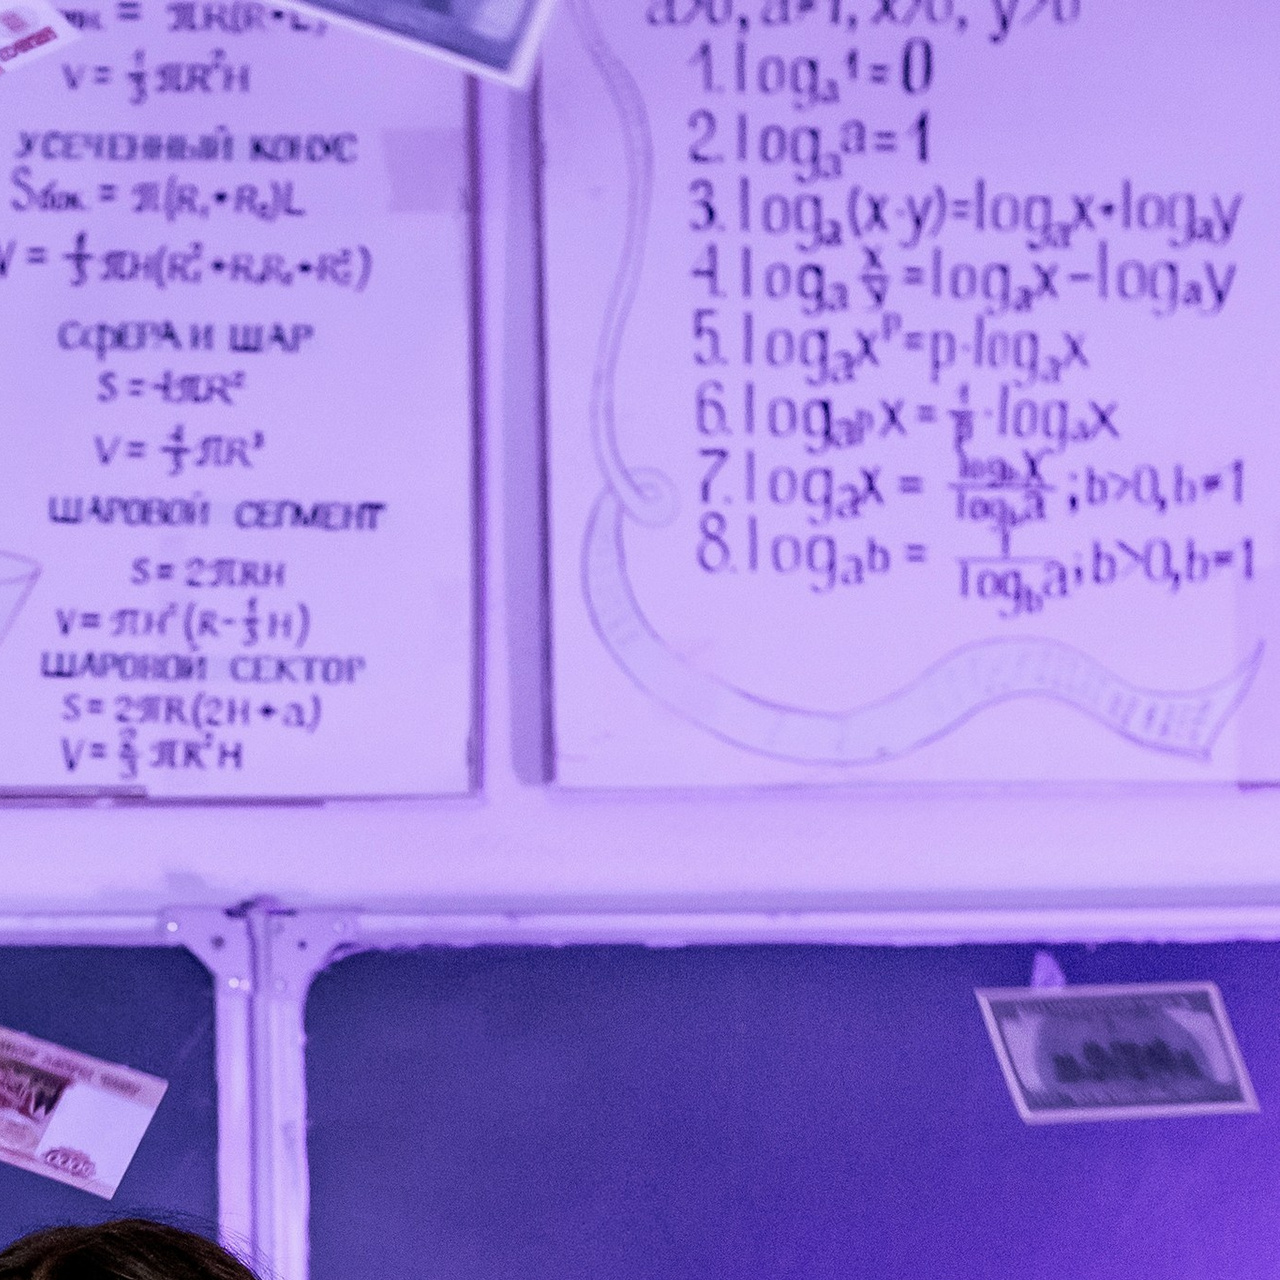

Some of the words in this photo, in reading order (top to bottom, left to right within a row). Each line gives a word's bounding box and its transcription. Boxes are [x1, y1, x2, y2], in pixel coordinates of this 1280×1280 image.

[227, 321, 315, 354] ШАР
[47, 489, 211, 527] ШАРОВОЙ
[233, 498, 387, 532] СЕГМЕНТ
[40, 647, 208, 682] ШАРОВОЙ
[229, 654, 367, 685] СЕКТОР
